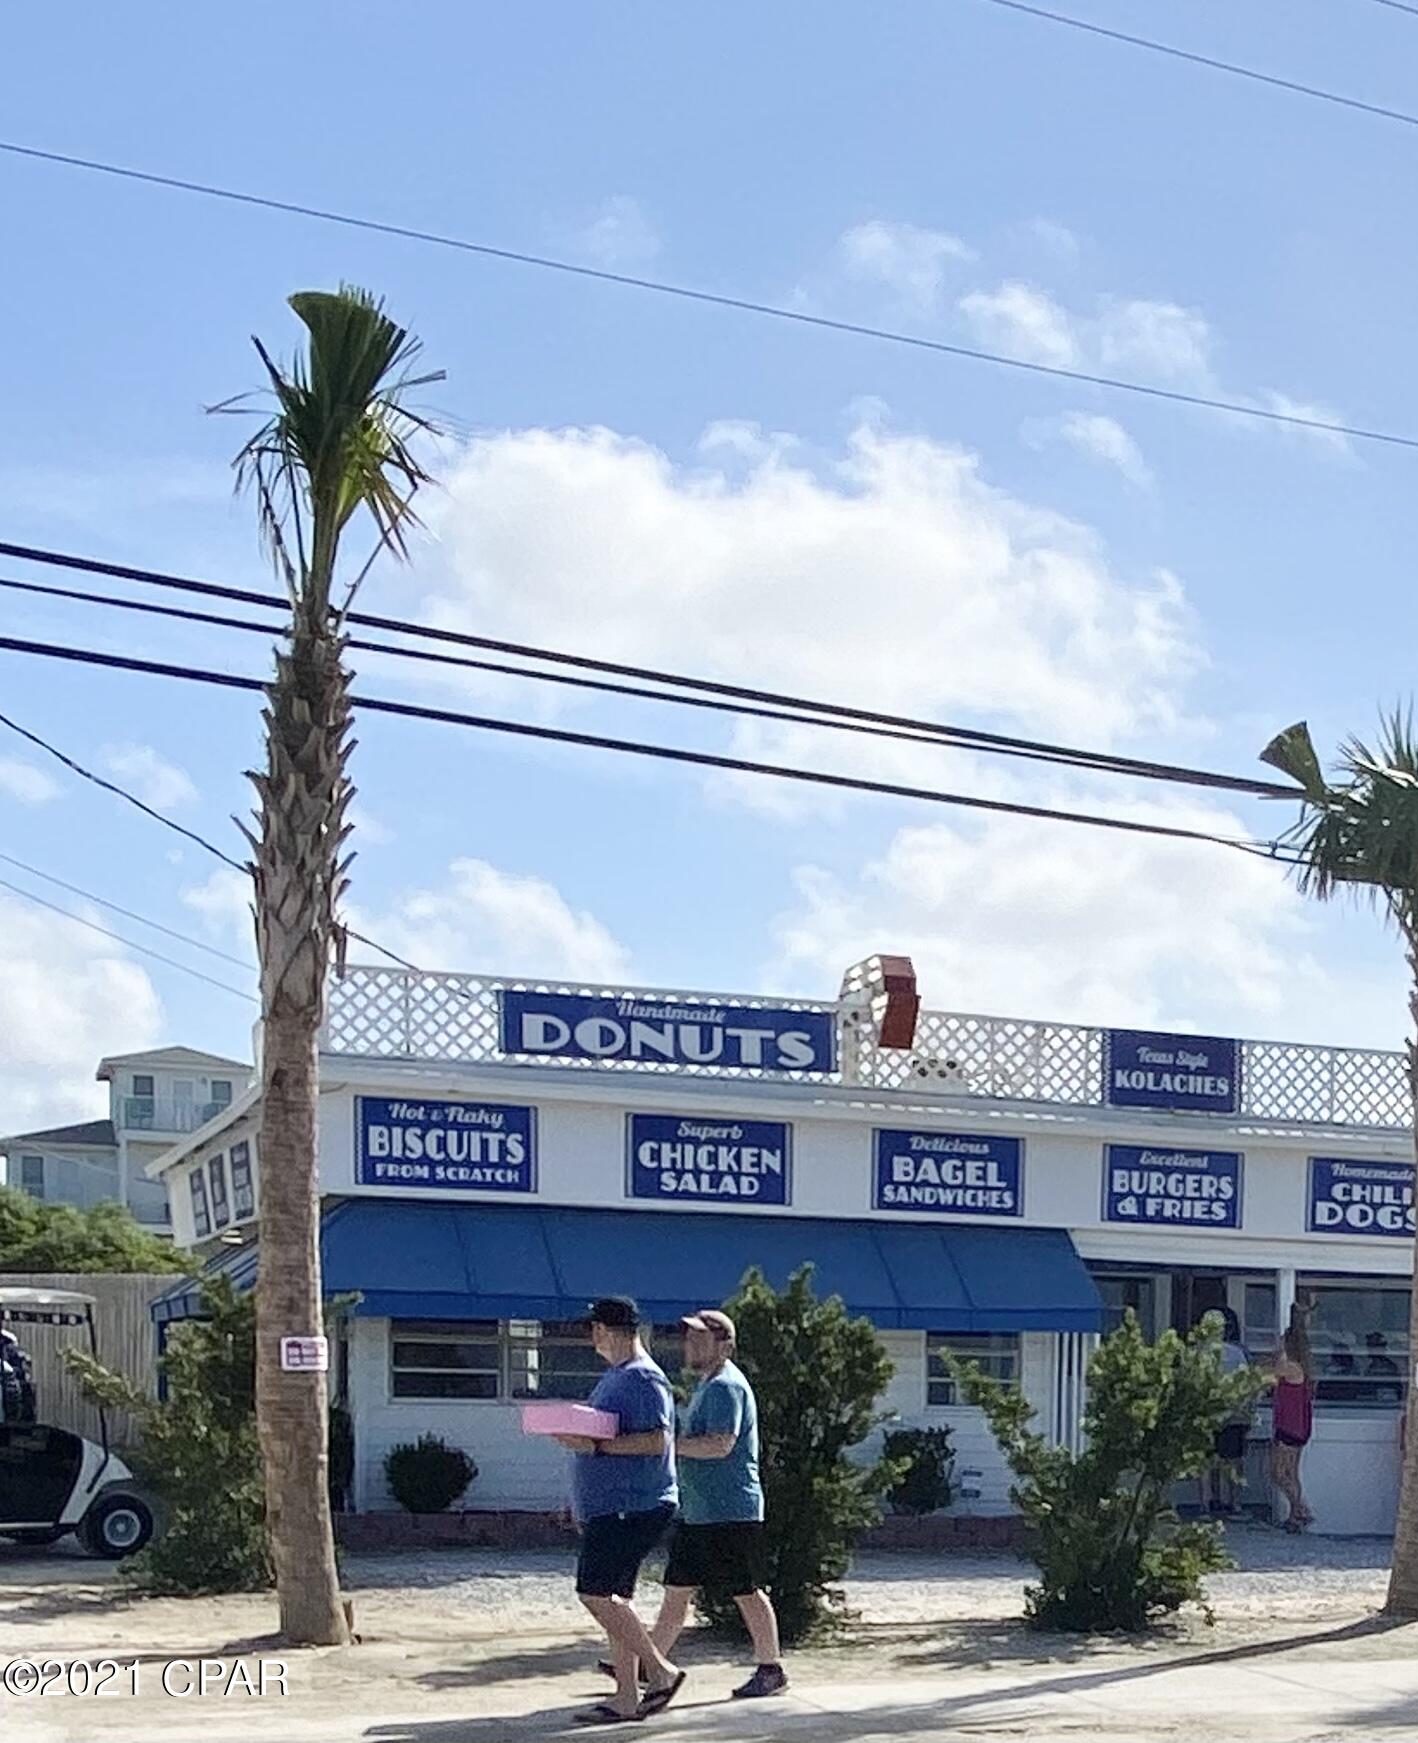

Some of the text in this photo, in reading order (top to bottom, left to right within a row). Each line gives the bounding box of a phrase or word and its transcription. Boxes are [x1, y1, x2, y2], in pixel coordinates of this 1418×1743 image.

[616, 1000, 727, 1023] Handmade
[521, 1013, 815, 1068] DONUTS
[1114, 1069, 1230, 1096] KOLACHES
[677, 1121, 743, 1141] Superb
[368, 1124, 525, 1165] BISCUITS
[910, 1136, 990, 1154] Delicious
[638, 1140, 781, 1175] CHICKEN
[375, 1163, 520, 1183] FROM SCRATCH
[660, 1170, 760, 1195] SALAD
[892, 1155, 1008, 1187] BAGEL
[882, 1184, 1015, 1209] SANDWICHES
[1112, 1169, 1235, 1200] BURGERS
[1331, 1182, 1413, 1205] CHILI
[1117, 1195, 1228, 1221] & FRIES
